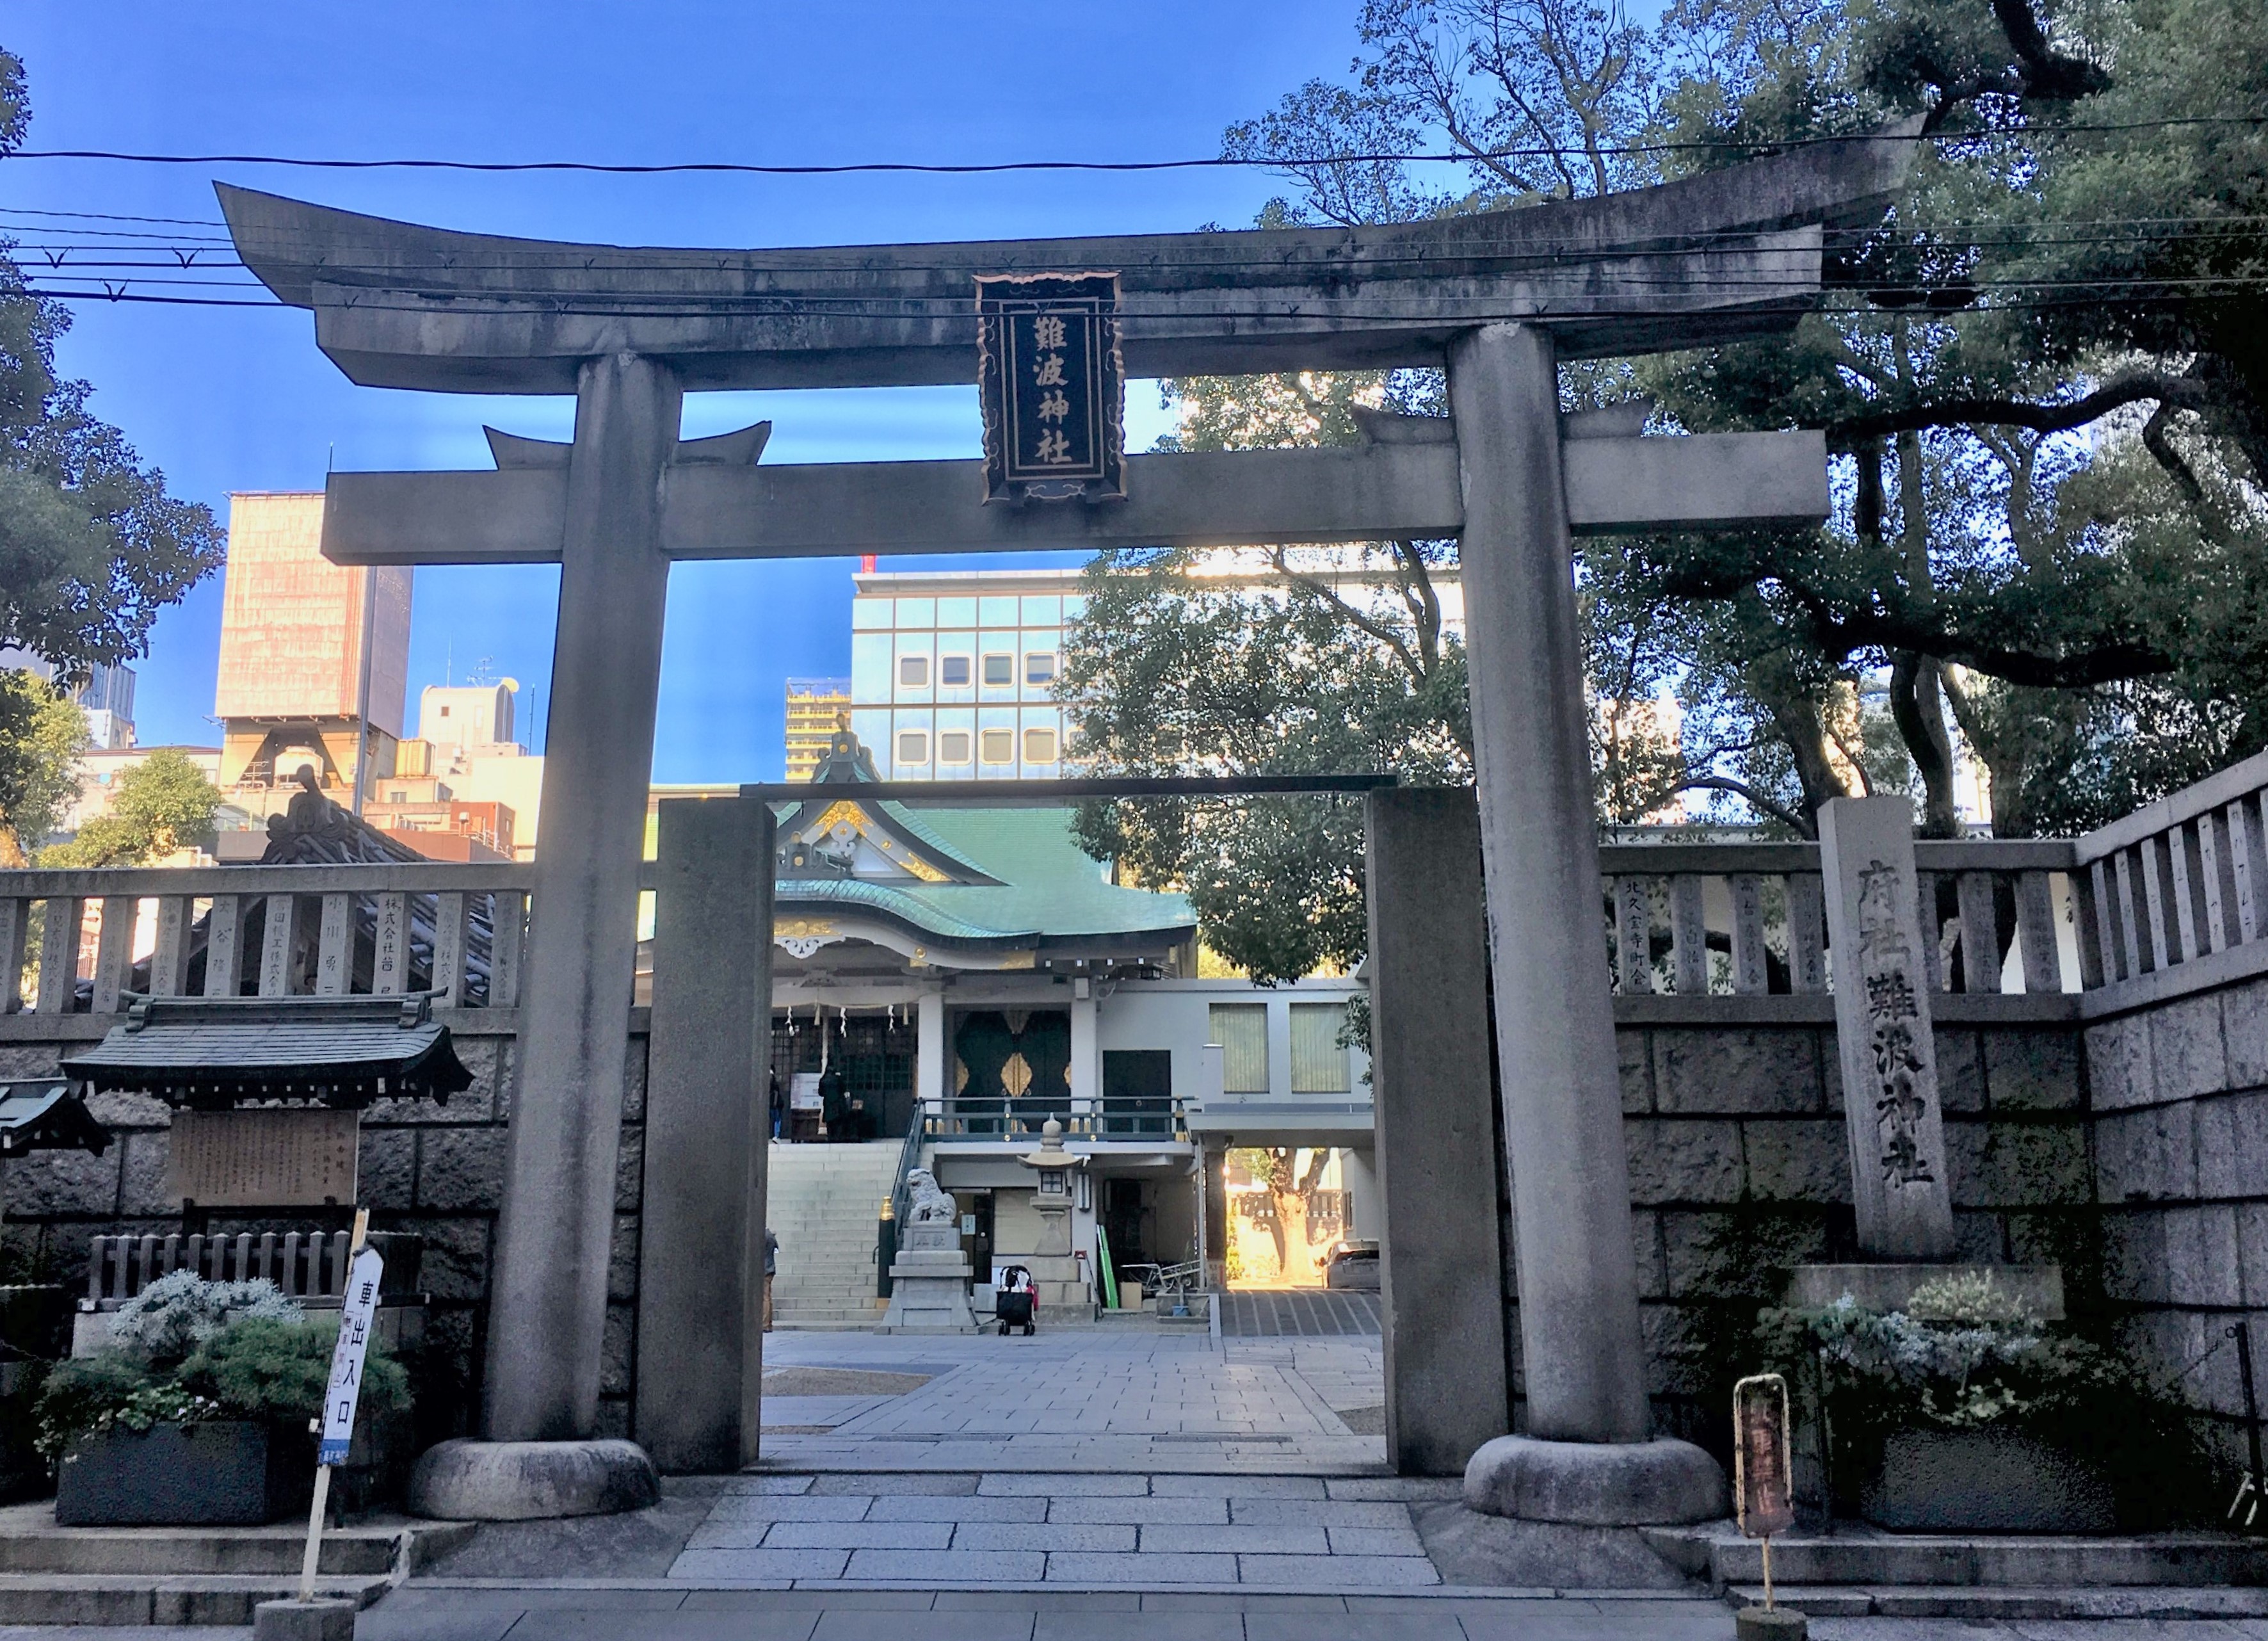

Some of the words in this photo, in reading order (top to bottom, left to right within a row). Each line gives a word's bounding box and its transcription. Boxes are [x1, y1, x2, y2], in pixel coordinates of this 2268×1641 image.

[1032, 316, 1072, 464] 難波神社
[1626, 881, 1646, 985] 北久宝寺町会
[1858, 859, 1934, 1189] 府社難波神社
[337, 1280, 374, 1424] 車出入口
